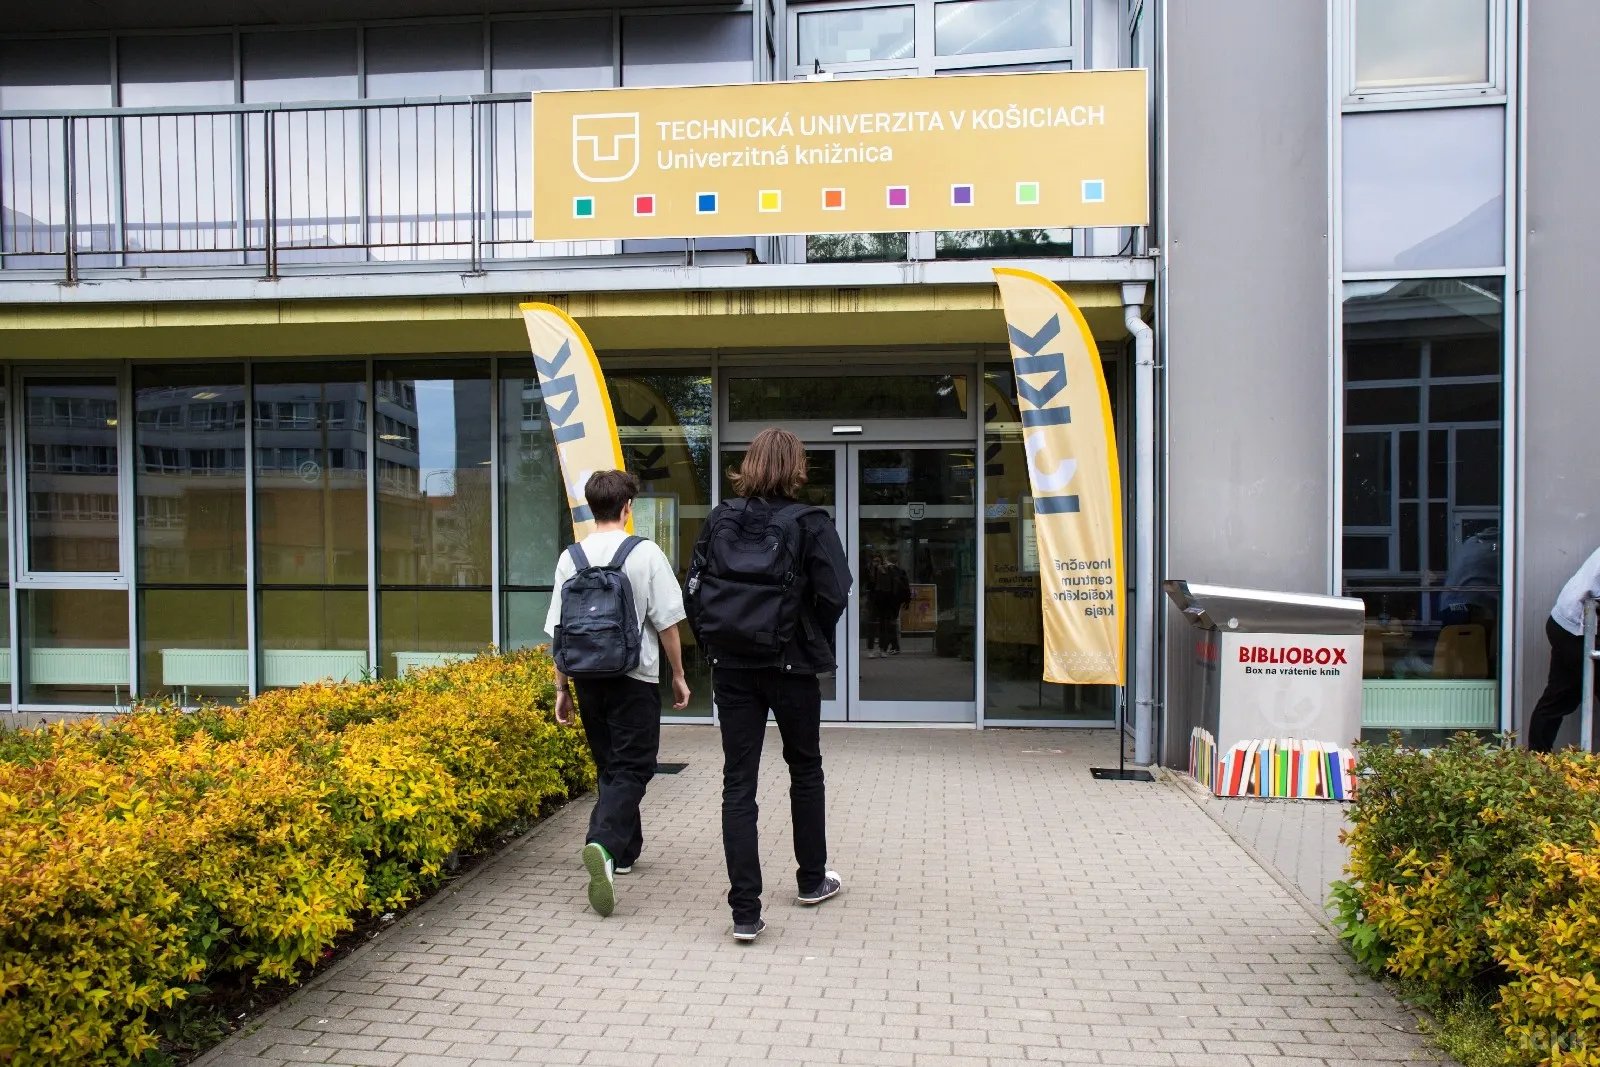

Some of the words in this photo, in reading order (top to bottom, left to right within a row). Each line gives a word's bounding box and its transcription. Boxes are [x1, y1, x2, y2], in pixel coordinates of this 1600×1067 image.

[656, 112, 794, 141] TECHNICKÁ
[799, 110, 944, 136] UNIVERZITA
[948, 109, 967, 130] V
[972, 103, 1105, 130] KOŠICIACH
[657, 145, 789, 170] Univerzitná
[795, 143, 893, 165] knižnica
[1239, 646, 1348, 665] BIBLIOBOX
[1245, 666, 1263, 675] Box
[1265, 667, 1277, 675] na
[1279, 666, 1317, 676] vrátenie
